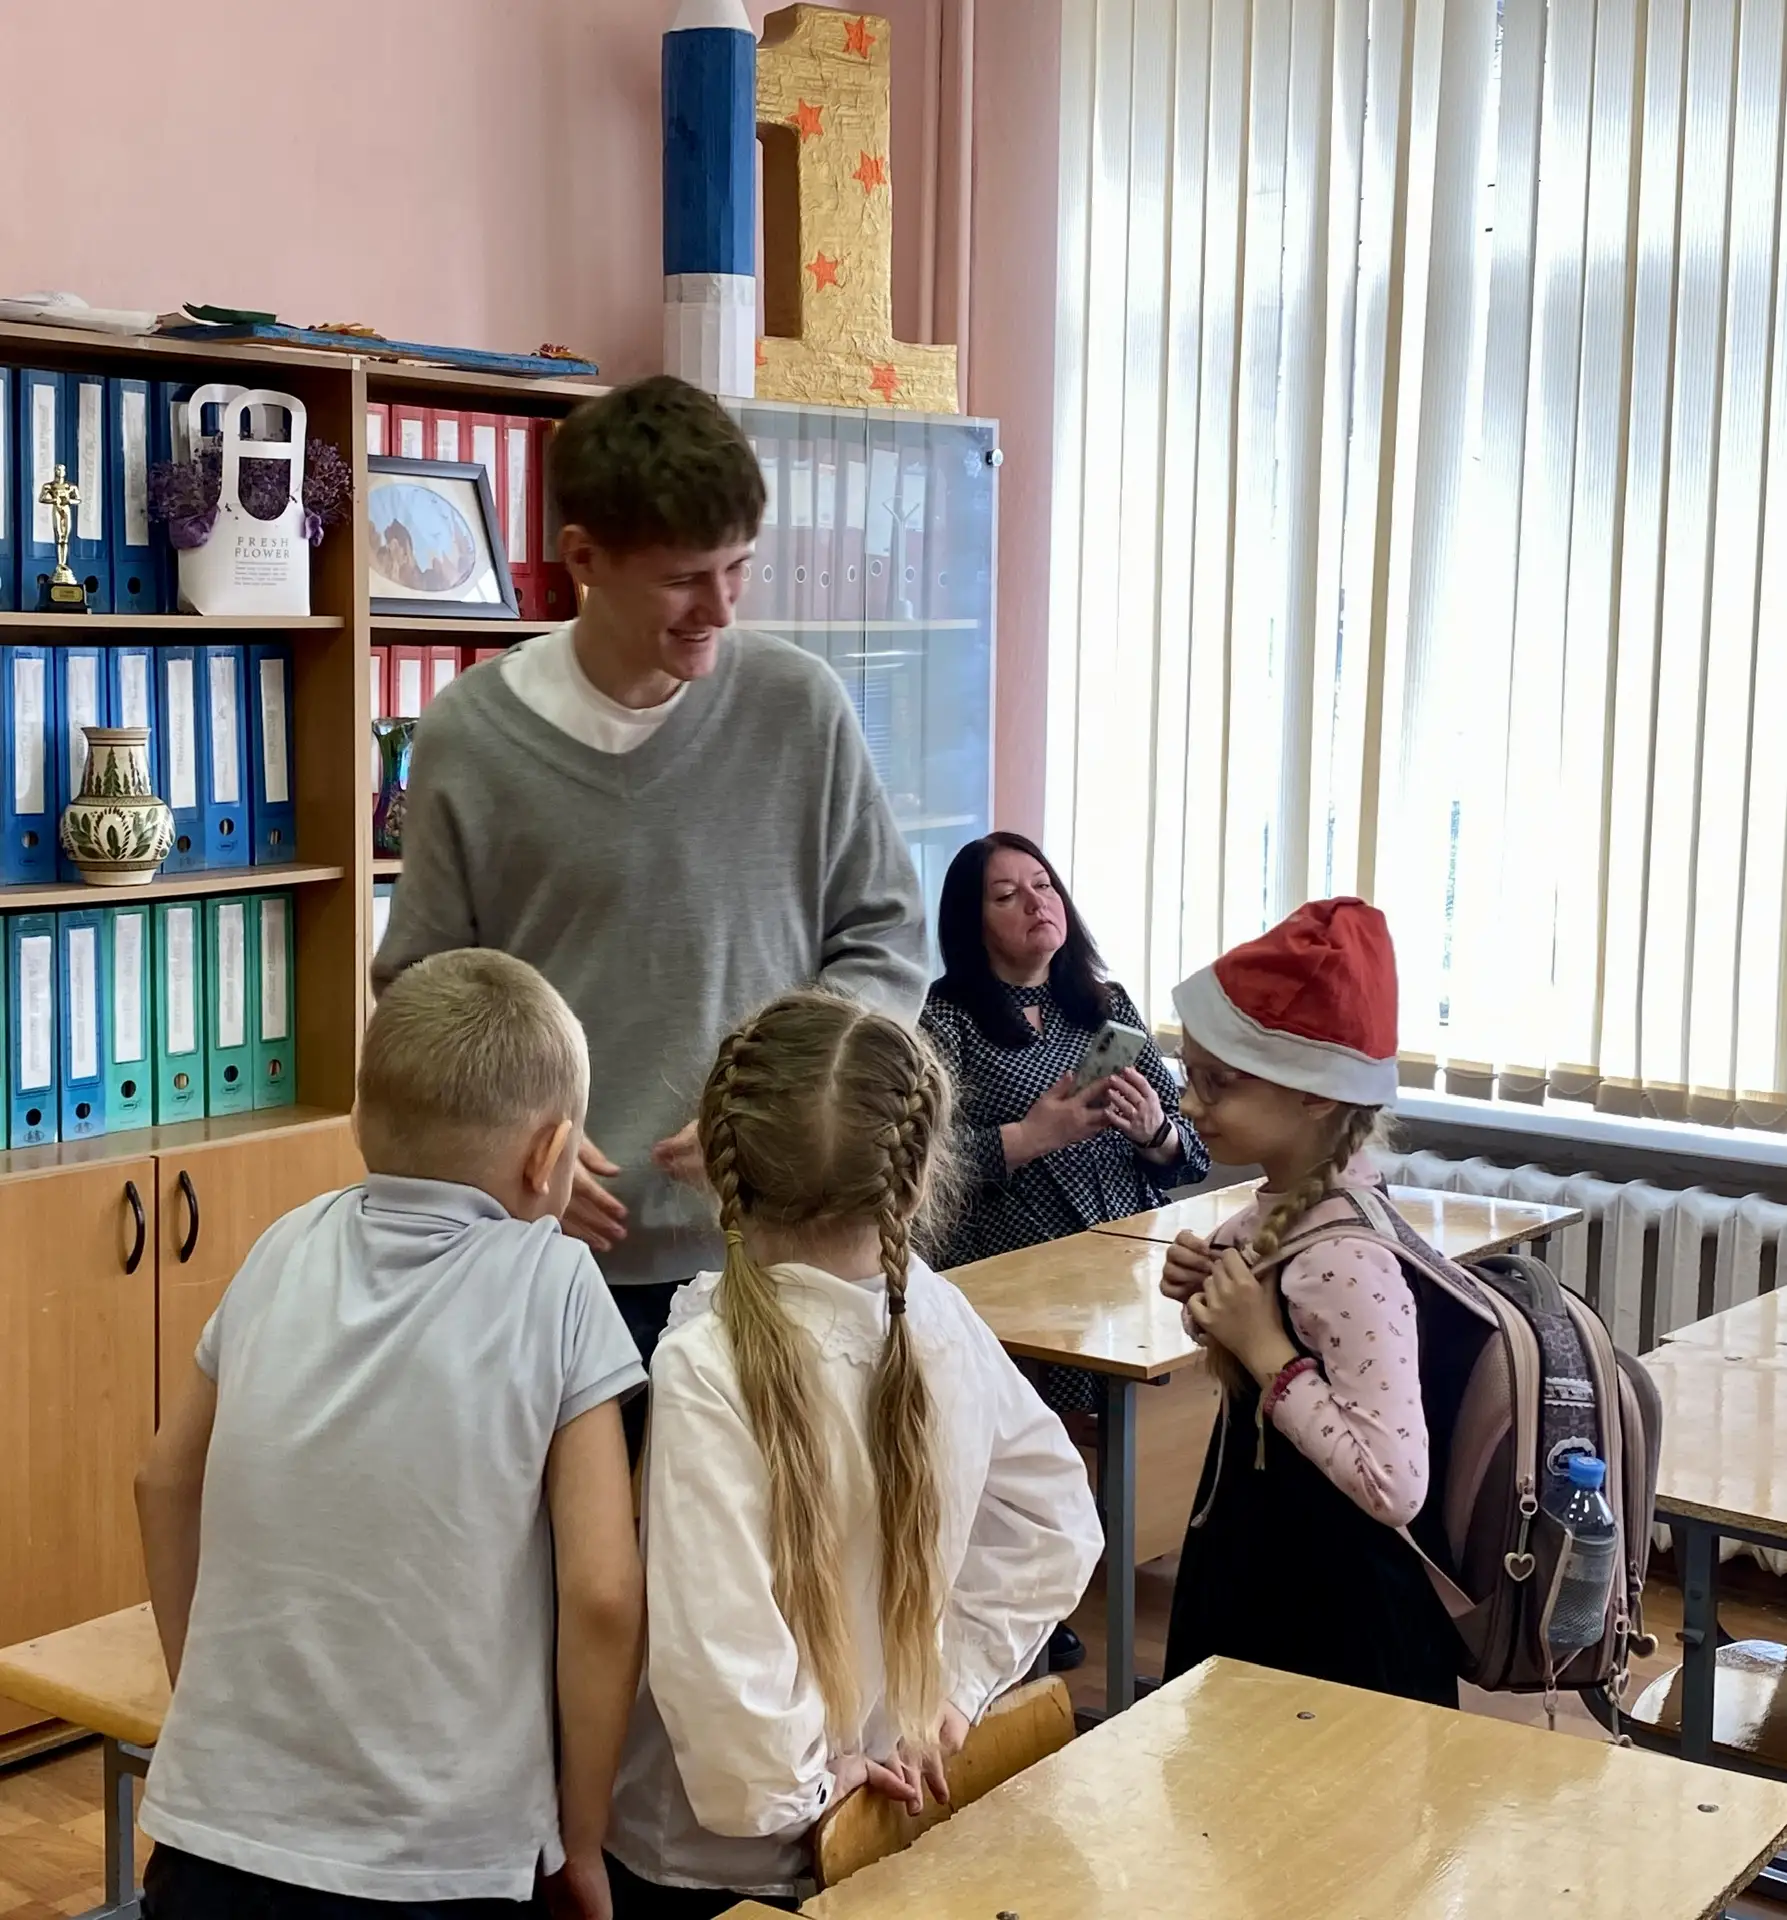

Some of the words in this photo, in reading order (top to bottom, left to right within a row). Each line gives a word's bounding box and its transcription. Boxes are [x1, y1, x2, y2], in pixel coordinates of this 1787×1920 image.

[756, 3, 959, 413] 1
[237, 536, 289, 548] FRESH
[234, 547, 290, 559] FLOWER
